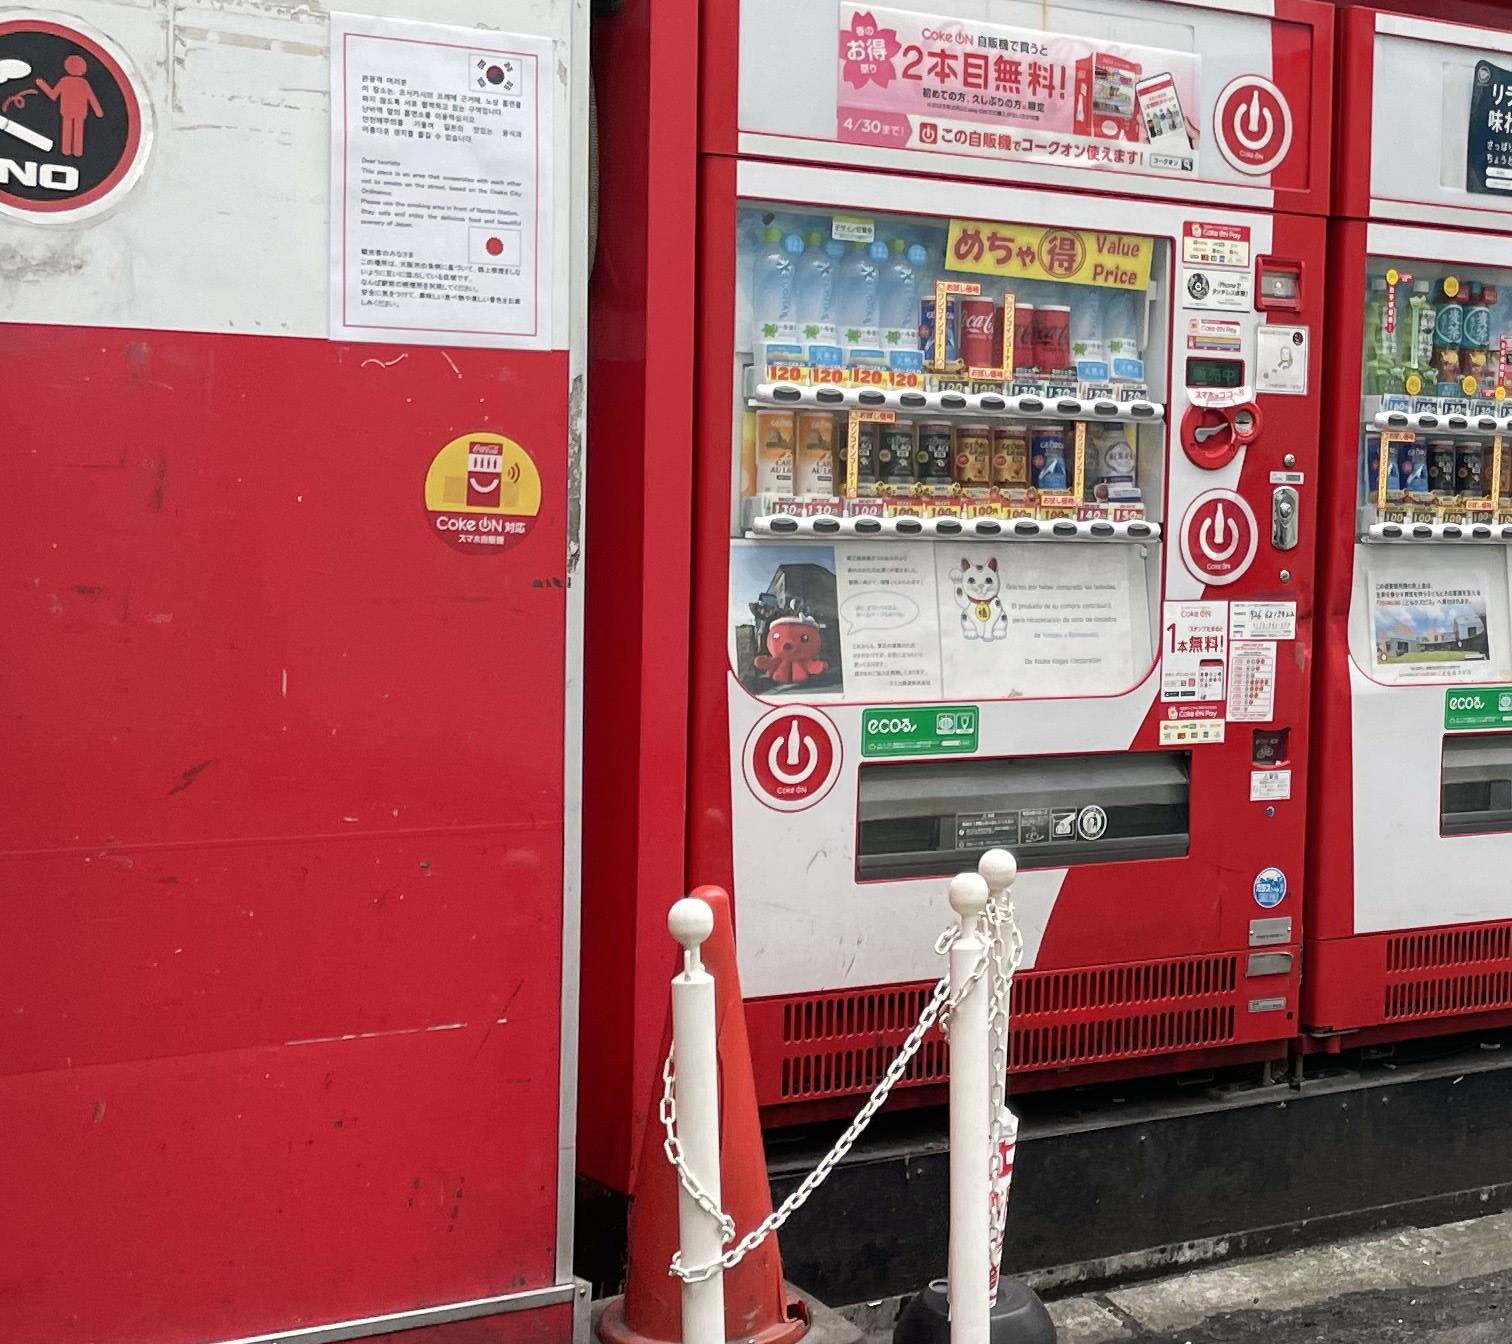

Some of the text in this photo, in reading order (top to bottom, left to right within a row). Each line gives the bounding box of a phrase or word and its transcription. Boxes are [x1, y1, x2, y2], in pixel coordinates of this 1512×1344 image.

[847, 38, 887, 61] お得
[922, 28, 952, 42] Coke
[977, 35, 1049, 57] 自販機で買うと
[902, 44, 1067, 100] 2本目無料!
[0, 158, 80, 191] NO
[1096, 235, 1140, 257] Value
[1092, 264, 1137, 285] Price
[436, 516, 526, 534] Coke ON 対応
